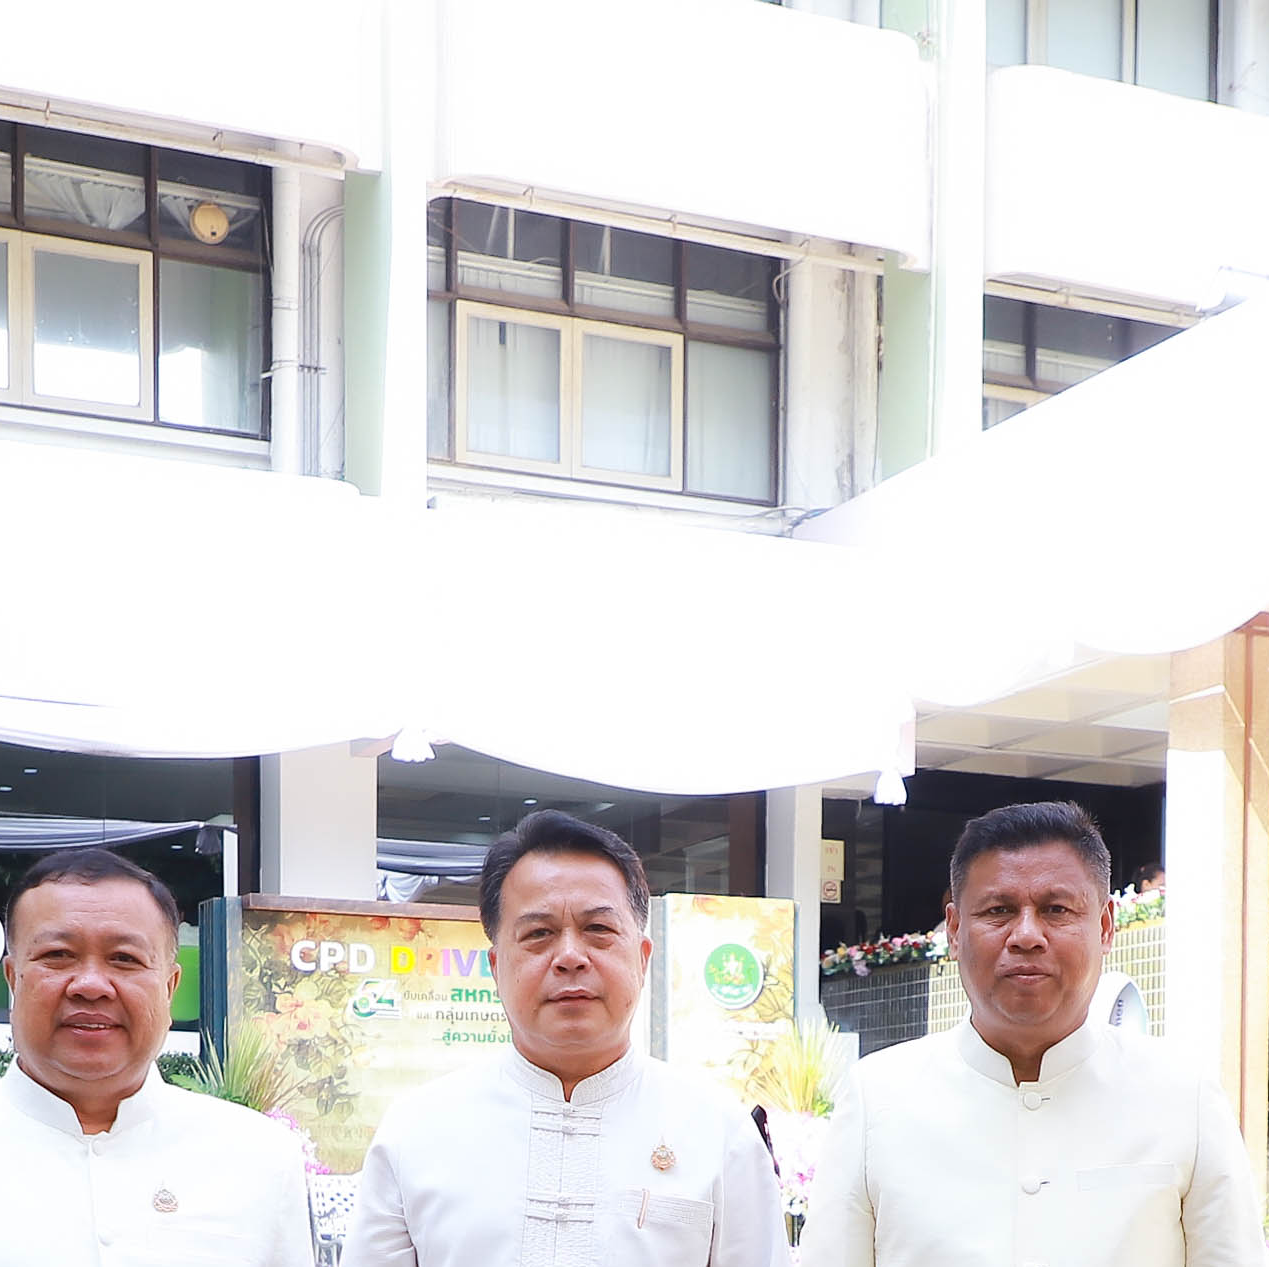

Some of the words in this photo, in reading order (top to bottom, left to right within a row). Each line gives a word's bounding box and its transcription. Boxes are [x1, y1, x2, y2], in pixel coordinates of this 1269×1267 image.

[291, 939, 376, 974] CPD
[451, 987, 502, 1004] สหกร
[435, 1007, 507, 1025] กลุ่มเกษตร
